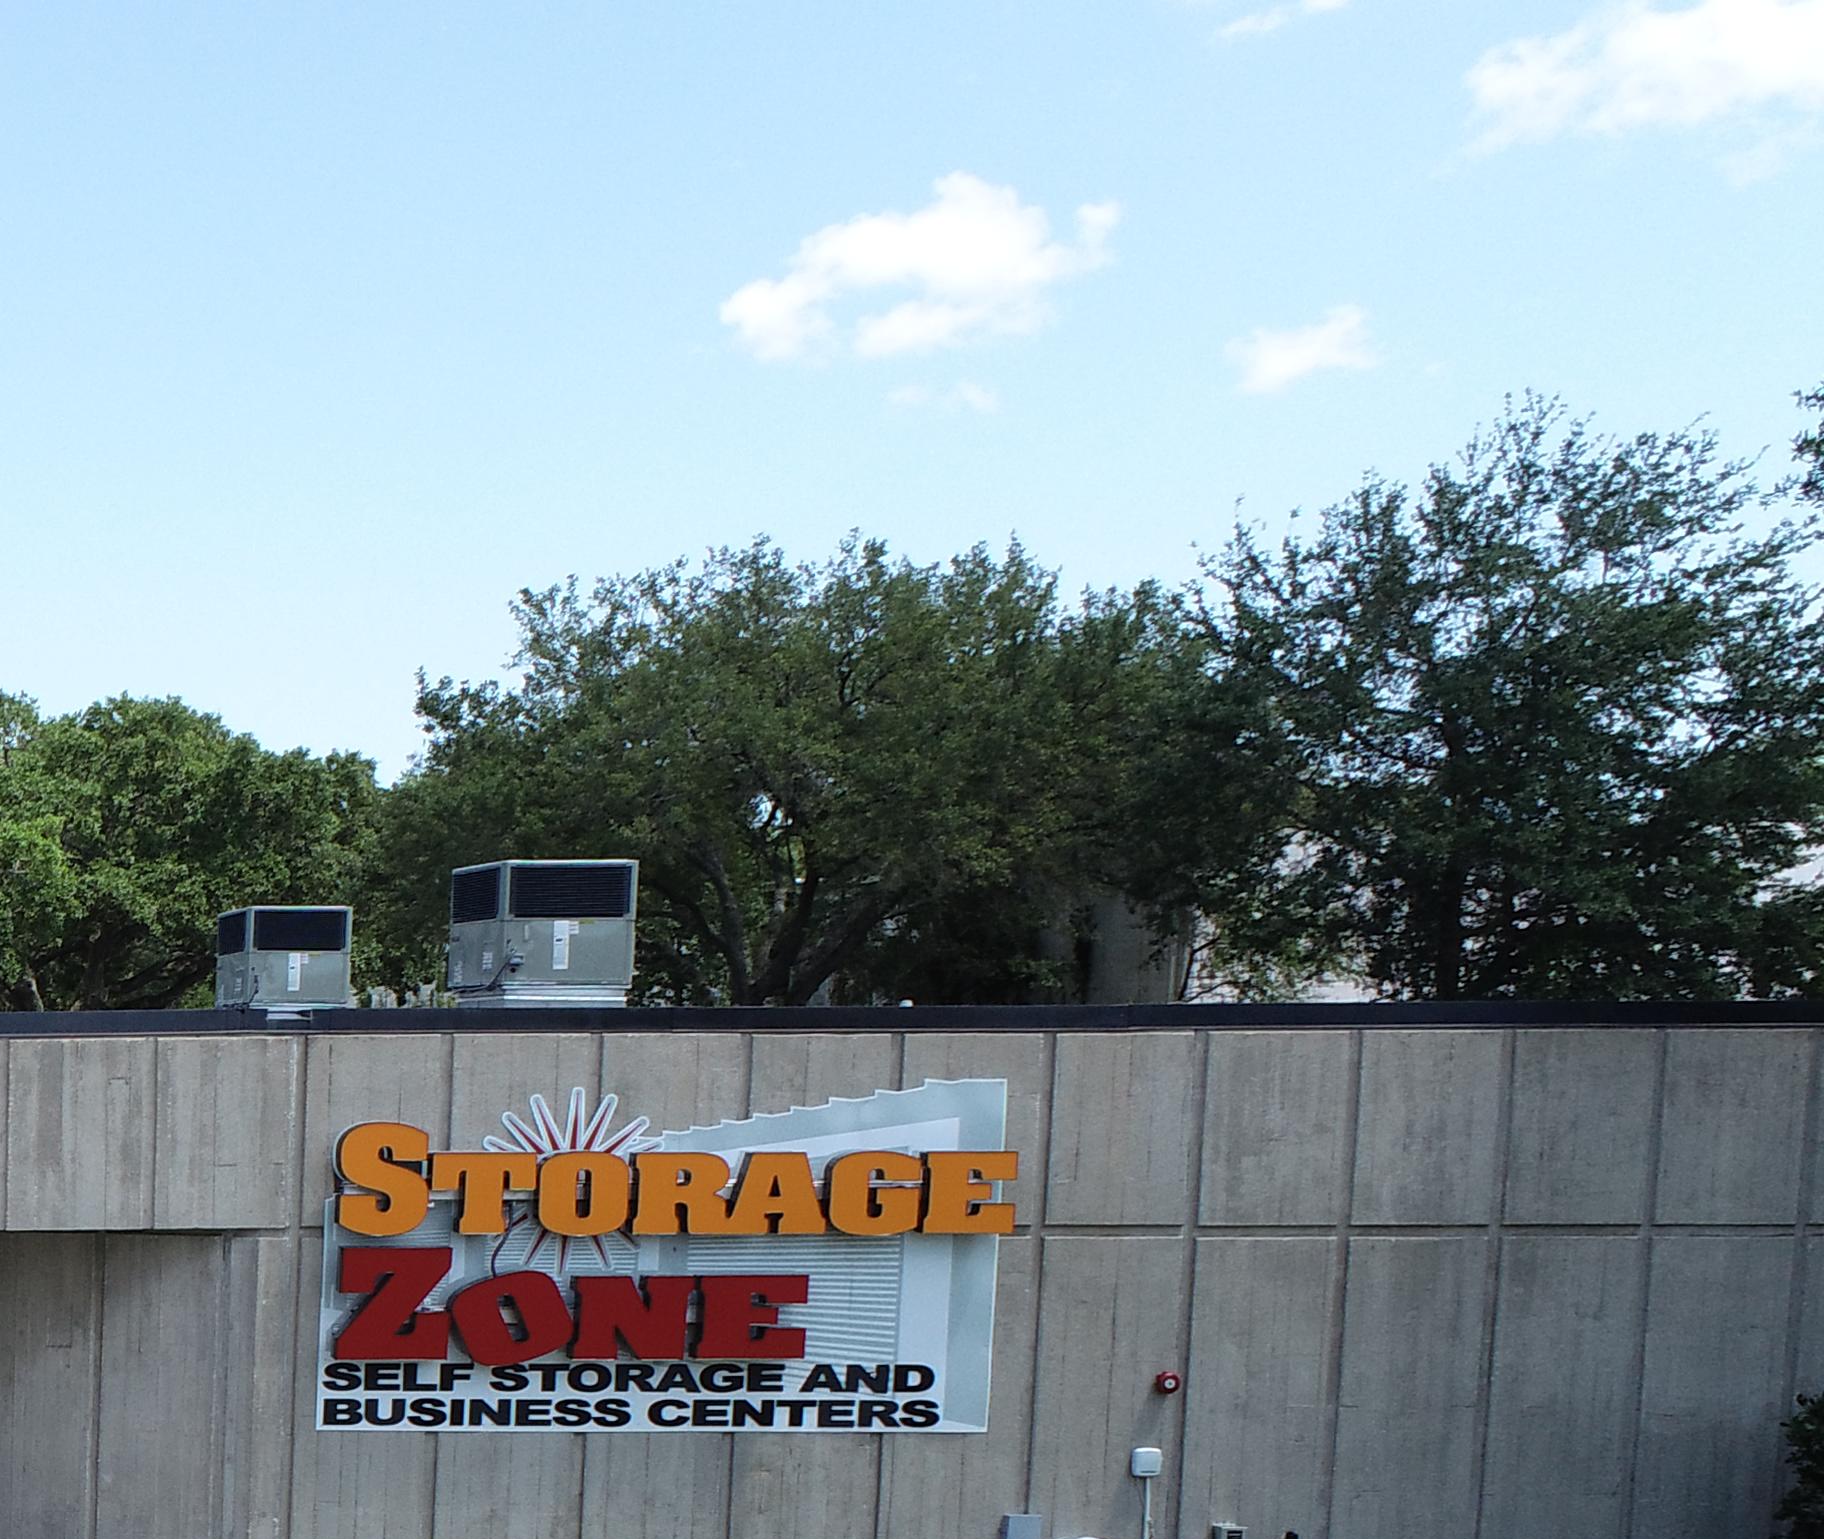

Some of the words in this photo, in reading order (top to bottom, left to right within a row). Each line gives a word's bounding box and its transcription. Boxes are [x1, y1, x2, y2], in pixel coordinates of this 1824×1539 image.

[334, 1121, 1019, 1237] STORAGE
[334, 1247, 809, 1366] ZONE
[322, 1362, 475, 1393] SELF
[489, 1363, 785, 1394] STORAGE
[798, 1364, 935, 1394] AND
[322, 1398, 632, 1427] BUSINESS
[647, 1399, 941, 1428] CENTERS
